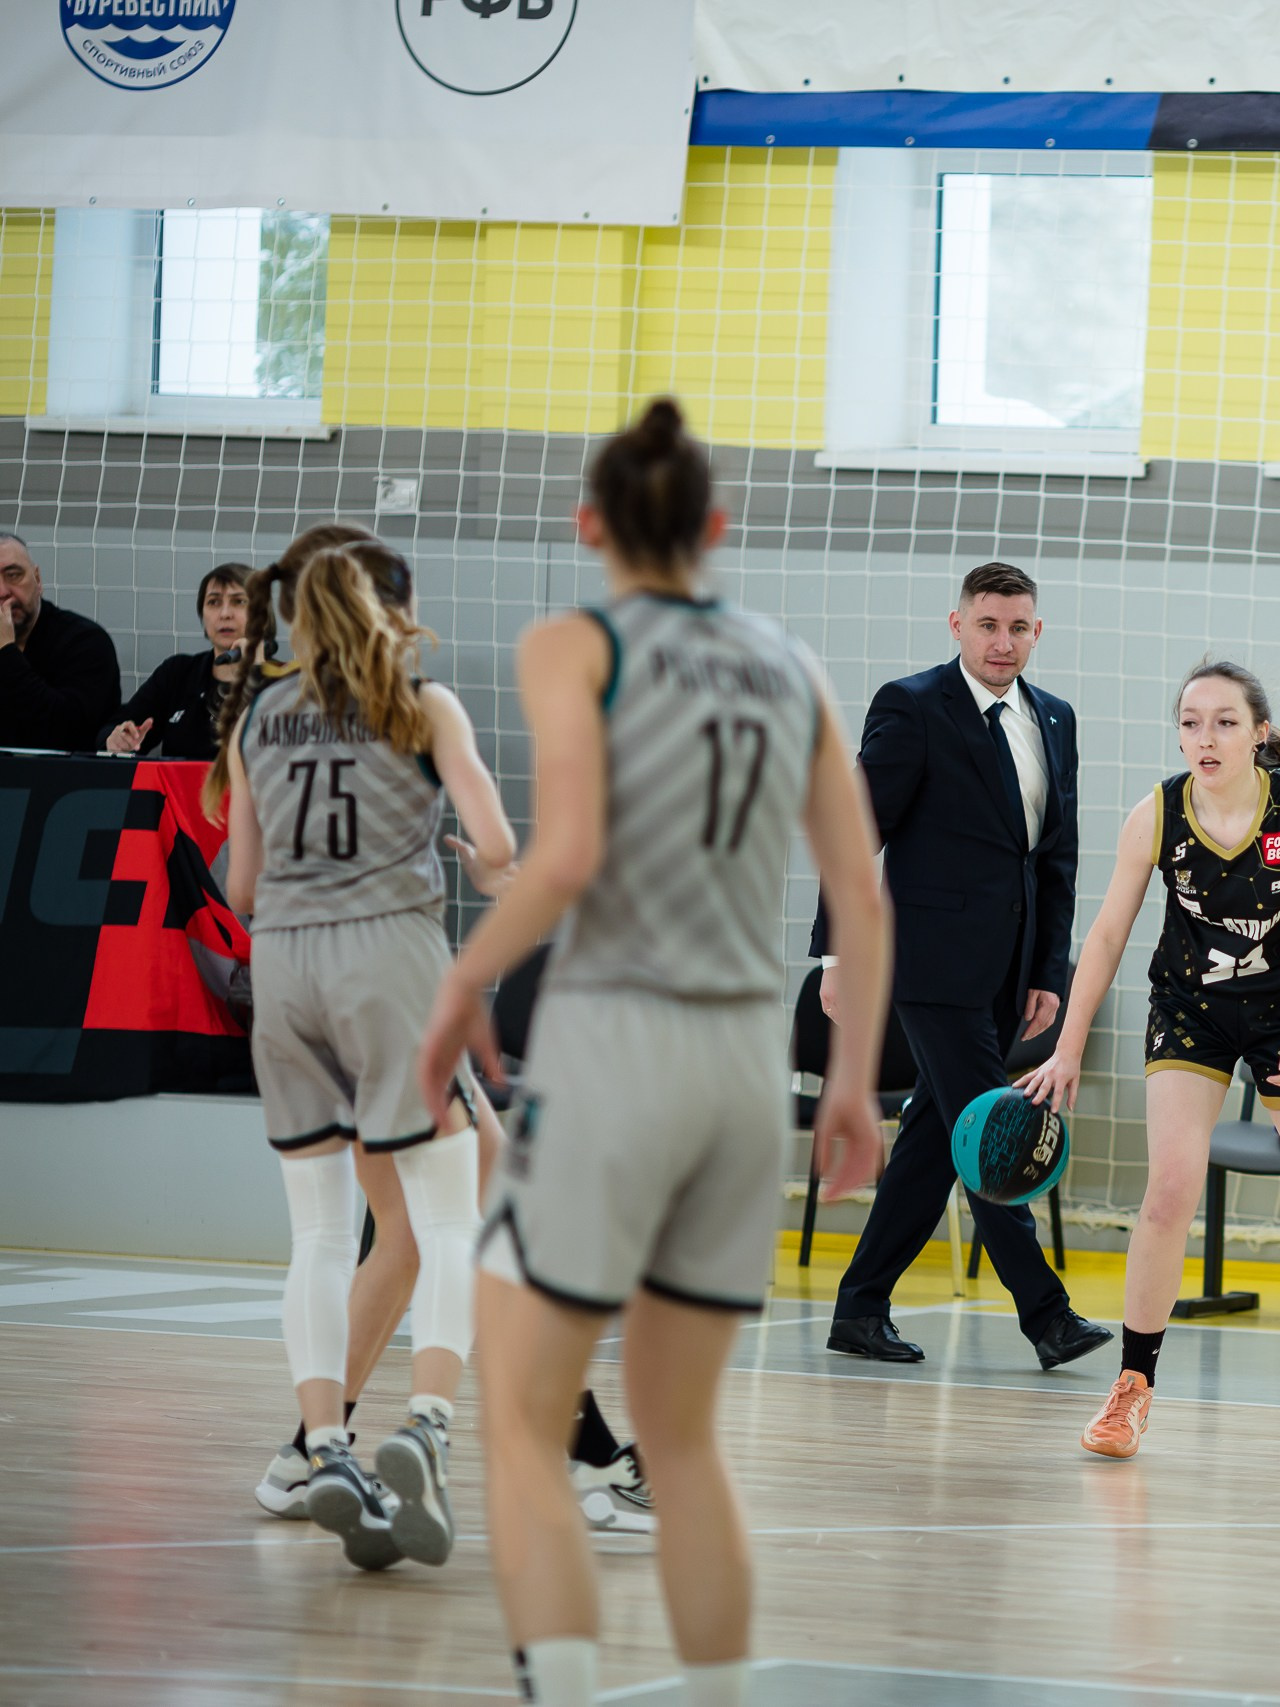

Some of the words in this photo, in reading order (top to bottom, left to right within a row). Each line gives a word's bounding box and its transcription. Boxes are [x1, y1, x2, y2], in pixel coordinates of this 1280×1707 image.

[82, 39, 167, 79] СПОРТИВНЫЙ
[169, 40, 205, 71] СОЮЗ
[288, 758, 358, 861] 75
[702, 715, 767, 853] 17
